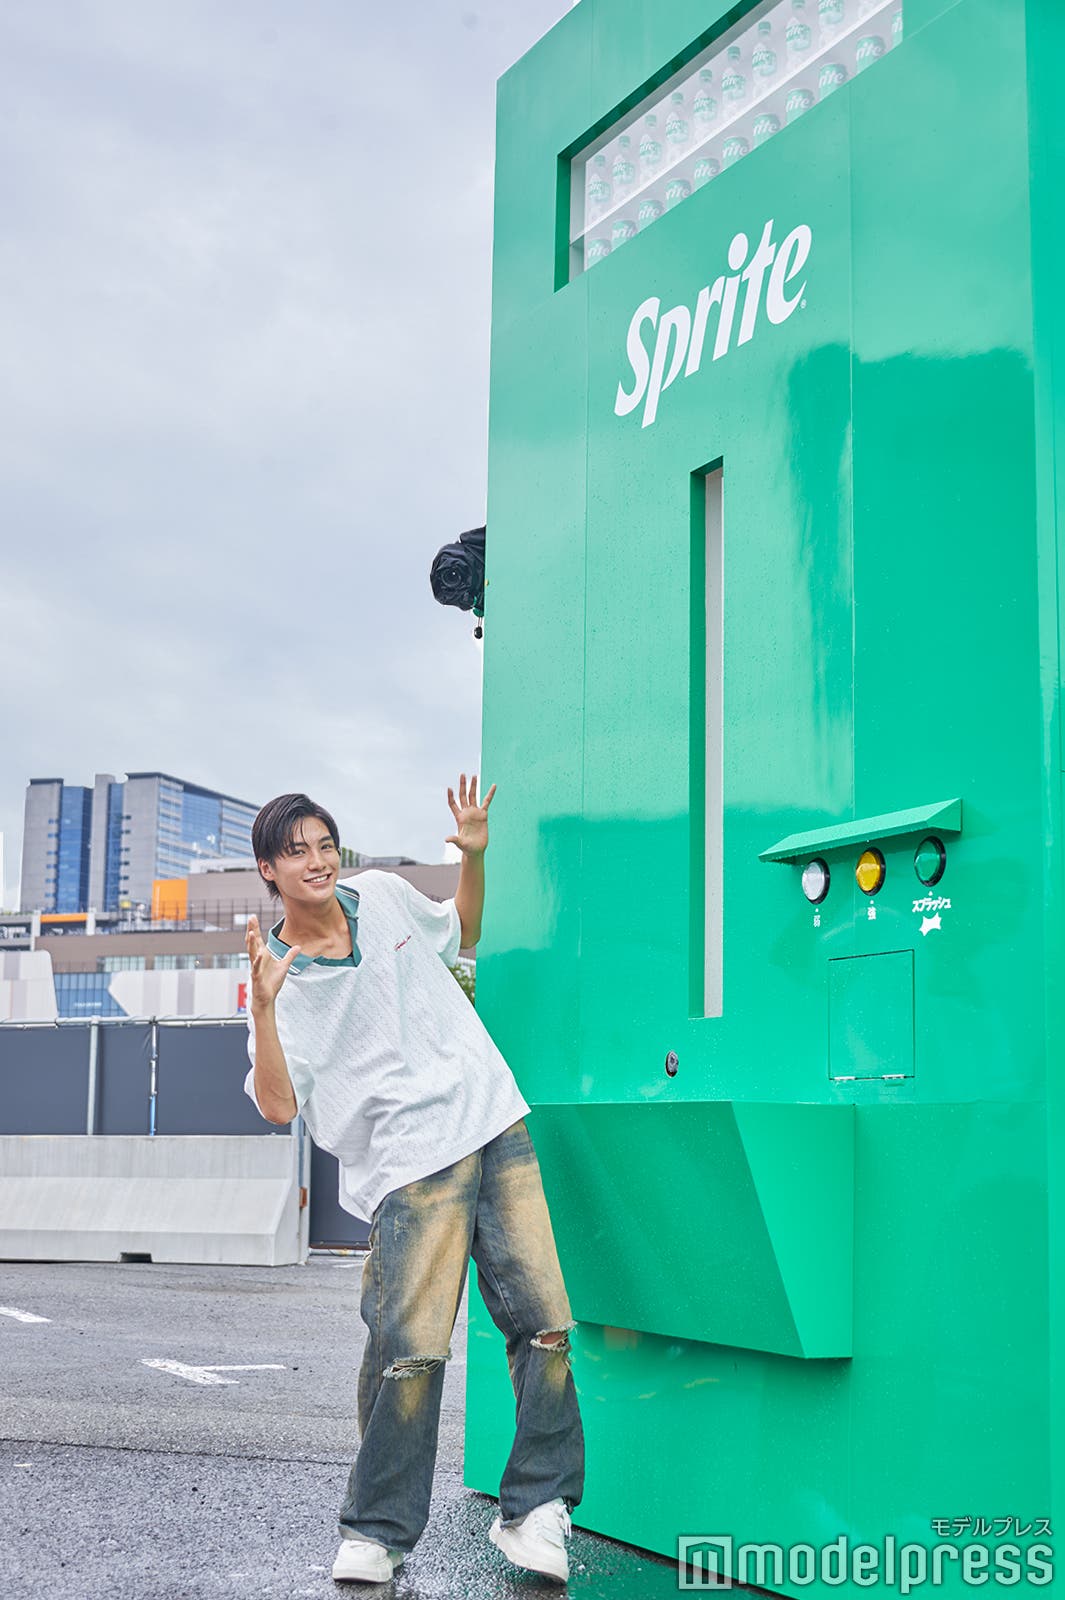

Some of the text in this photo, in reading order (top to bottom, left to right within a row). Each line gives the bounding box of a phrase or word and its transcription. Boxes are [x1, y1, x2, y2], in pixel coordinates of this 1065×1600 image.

[614, 218, 812, 429] Sprite
[912, 896, 952, 913] スプラッシュ
